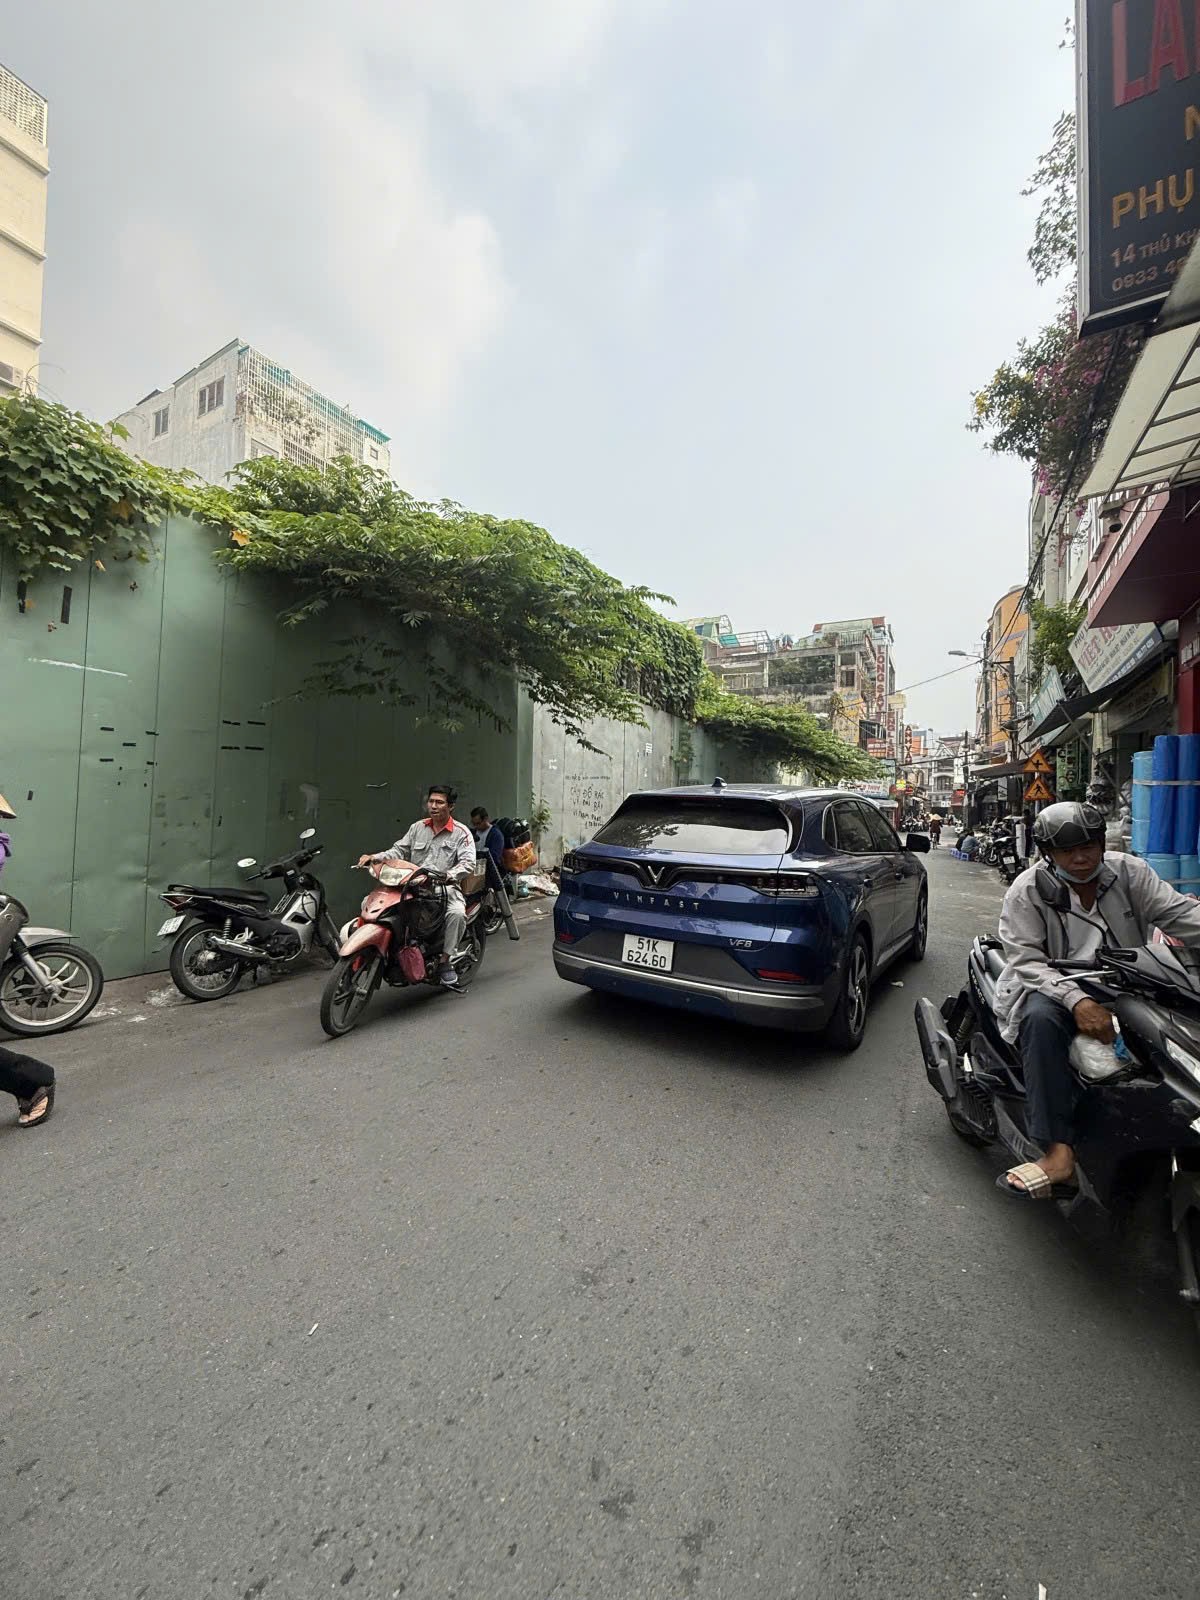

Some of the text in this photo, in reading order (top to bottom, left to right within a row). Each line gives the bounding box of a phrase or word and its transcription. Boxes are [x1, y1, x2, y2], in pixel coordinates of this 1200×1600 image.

[1111, 0, 1200, 107] LA
[1112, 167, 1194, 230] PHỤ
[1111, 243, 1137, 269] 14
[877, 645, 885, 683] LONG
[613, 891, 699, 910] VINFAST
[627, 949, 667, 968] 624.60
[637, 938, 659, 953] 51K
